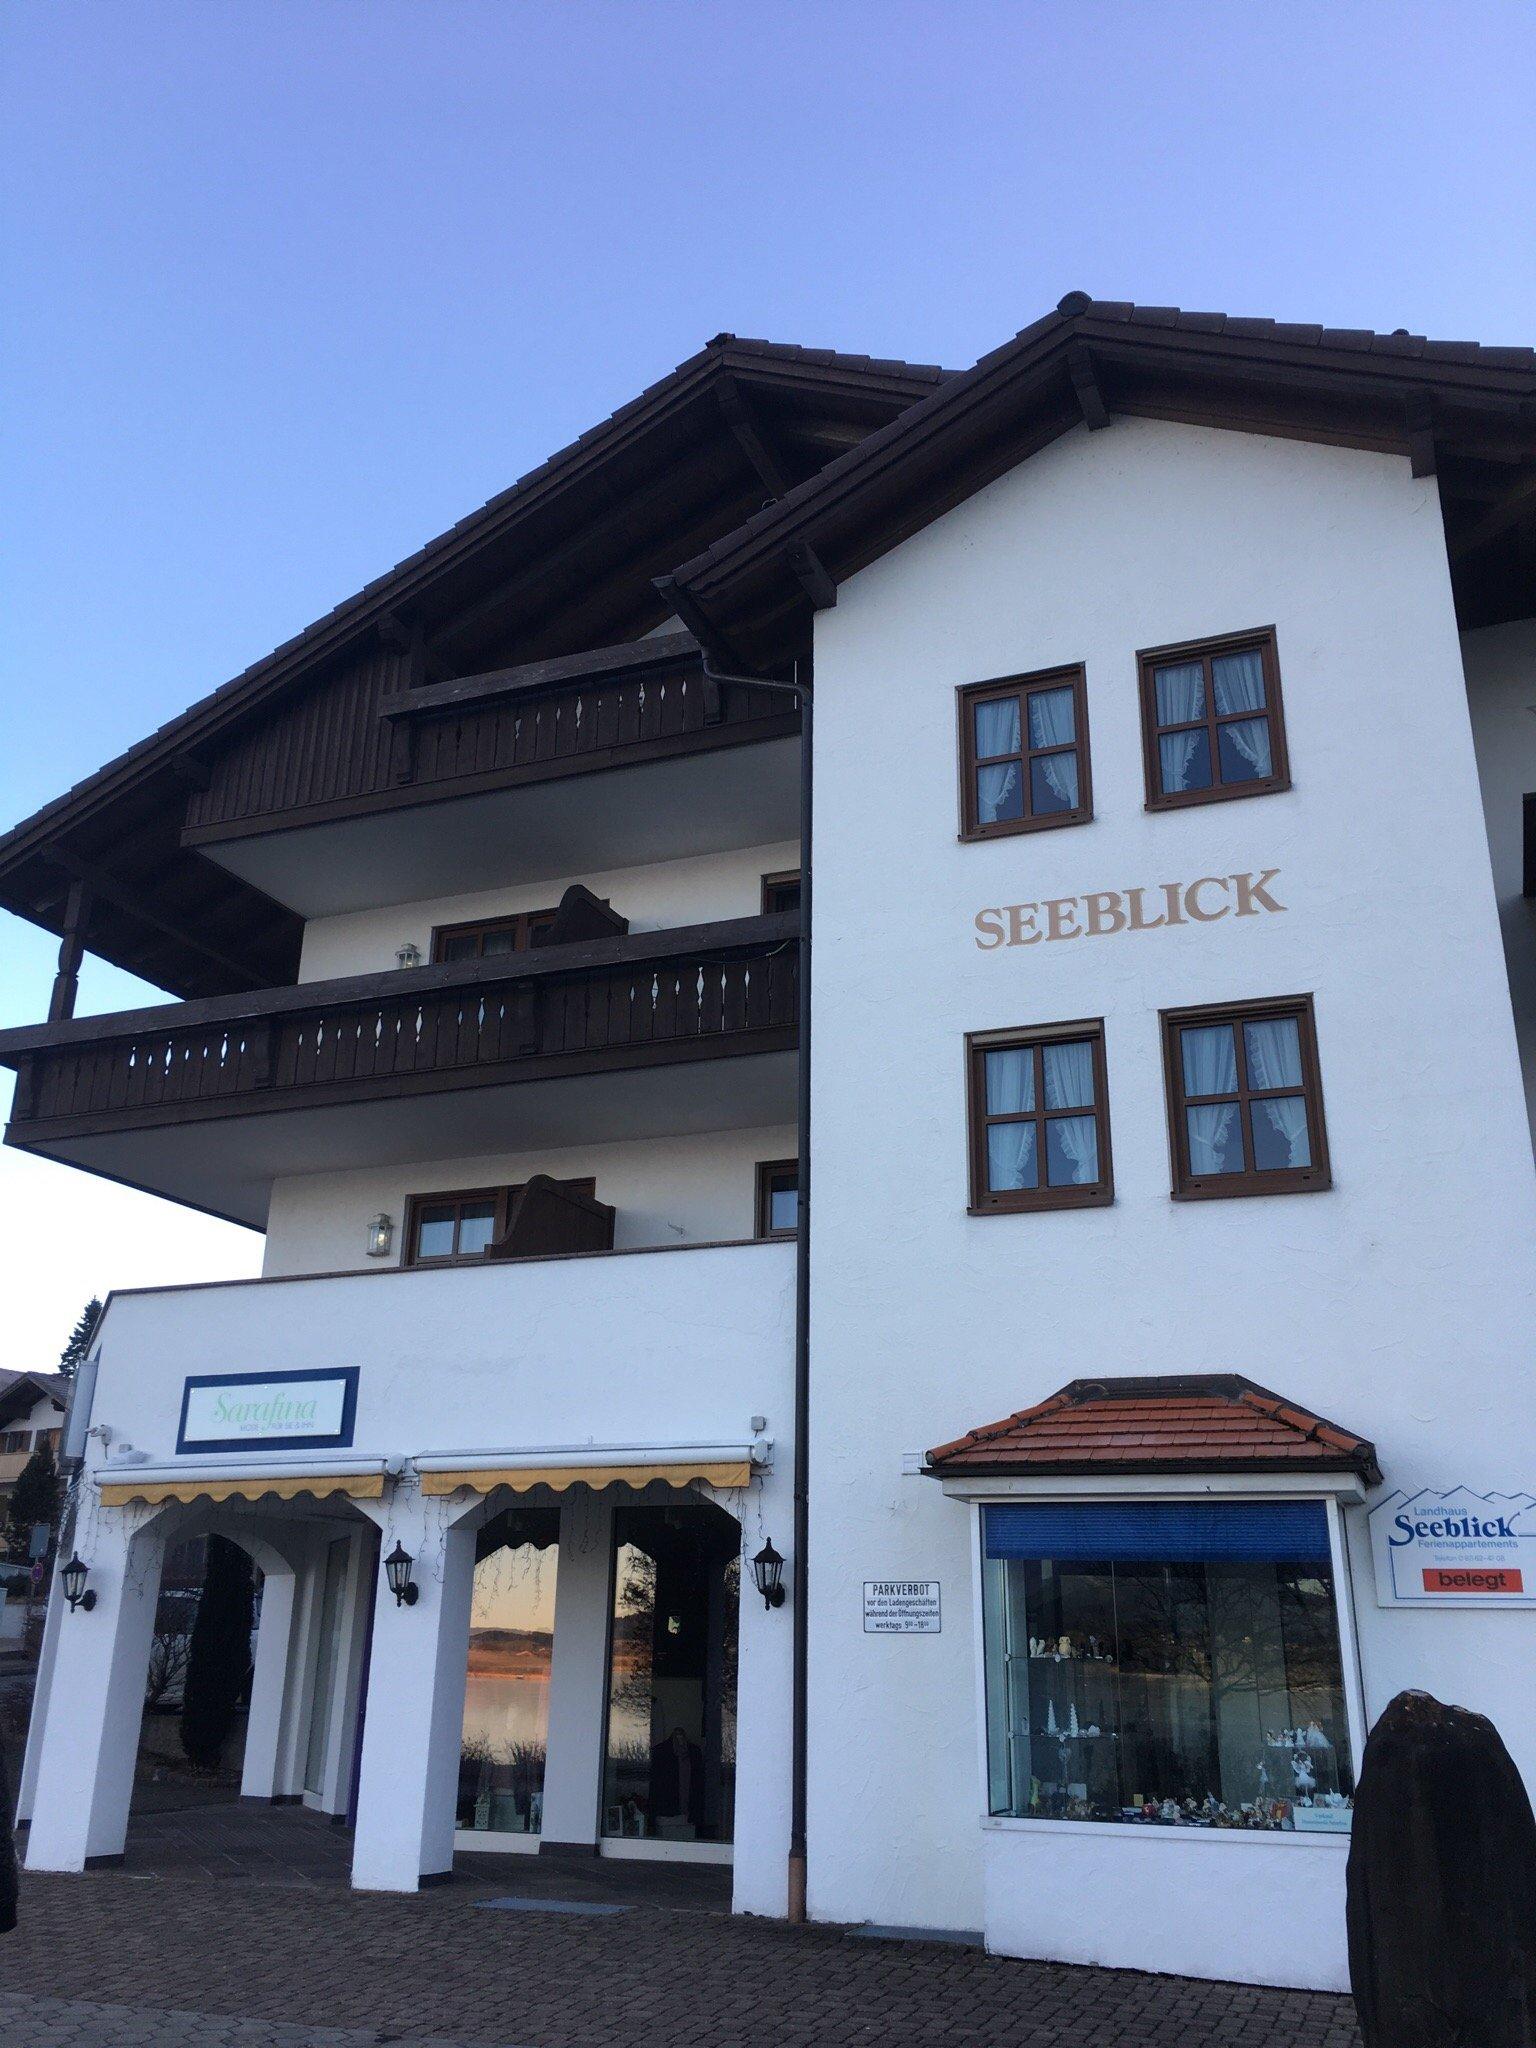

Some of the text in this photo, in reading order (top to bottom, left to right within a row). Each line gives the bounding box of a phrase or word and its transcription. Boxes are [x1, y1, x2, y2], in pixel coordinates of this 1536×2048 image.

[974, 868, 1289, 950] SEEBLICK
[214, 1390, 317, 1427] Sarafina
[1414, 1506, 1467, 1516] Landhaus
[1388, 1512, 1520, 1546] Seeblick
[1418, 1540, 1519, 1549] Ferienappartements
[873, 1584, 930, 1596] PARKVERBOT
[1438, 1572, 1506, 1590] belegt
